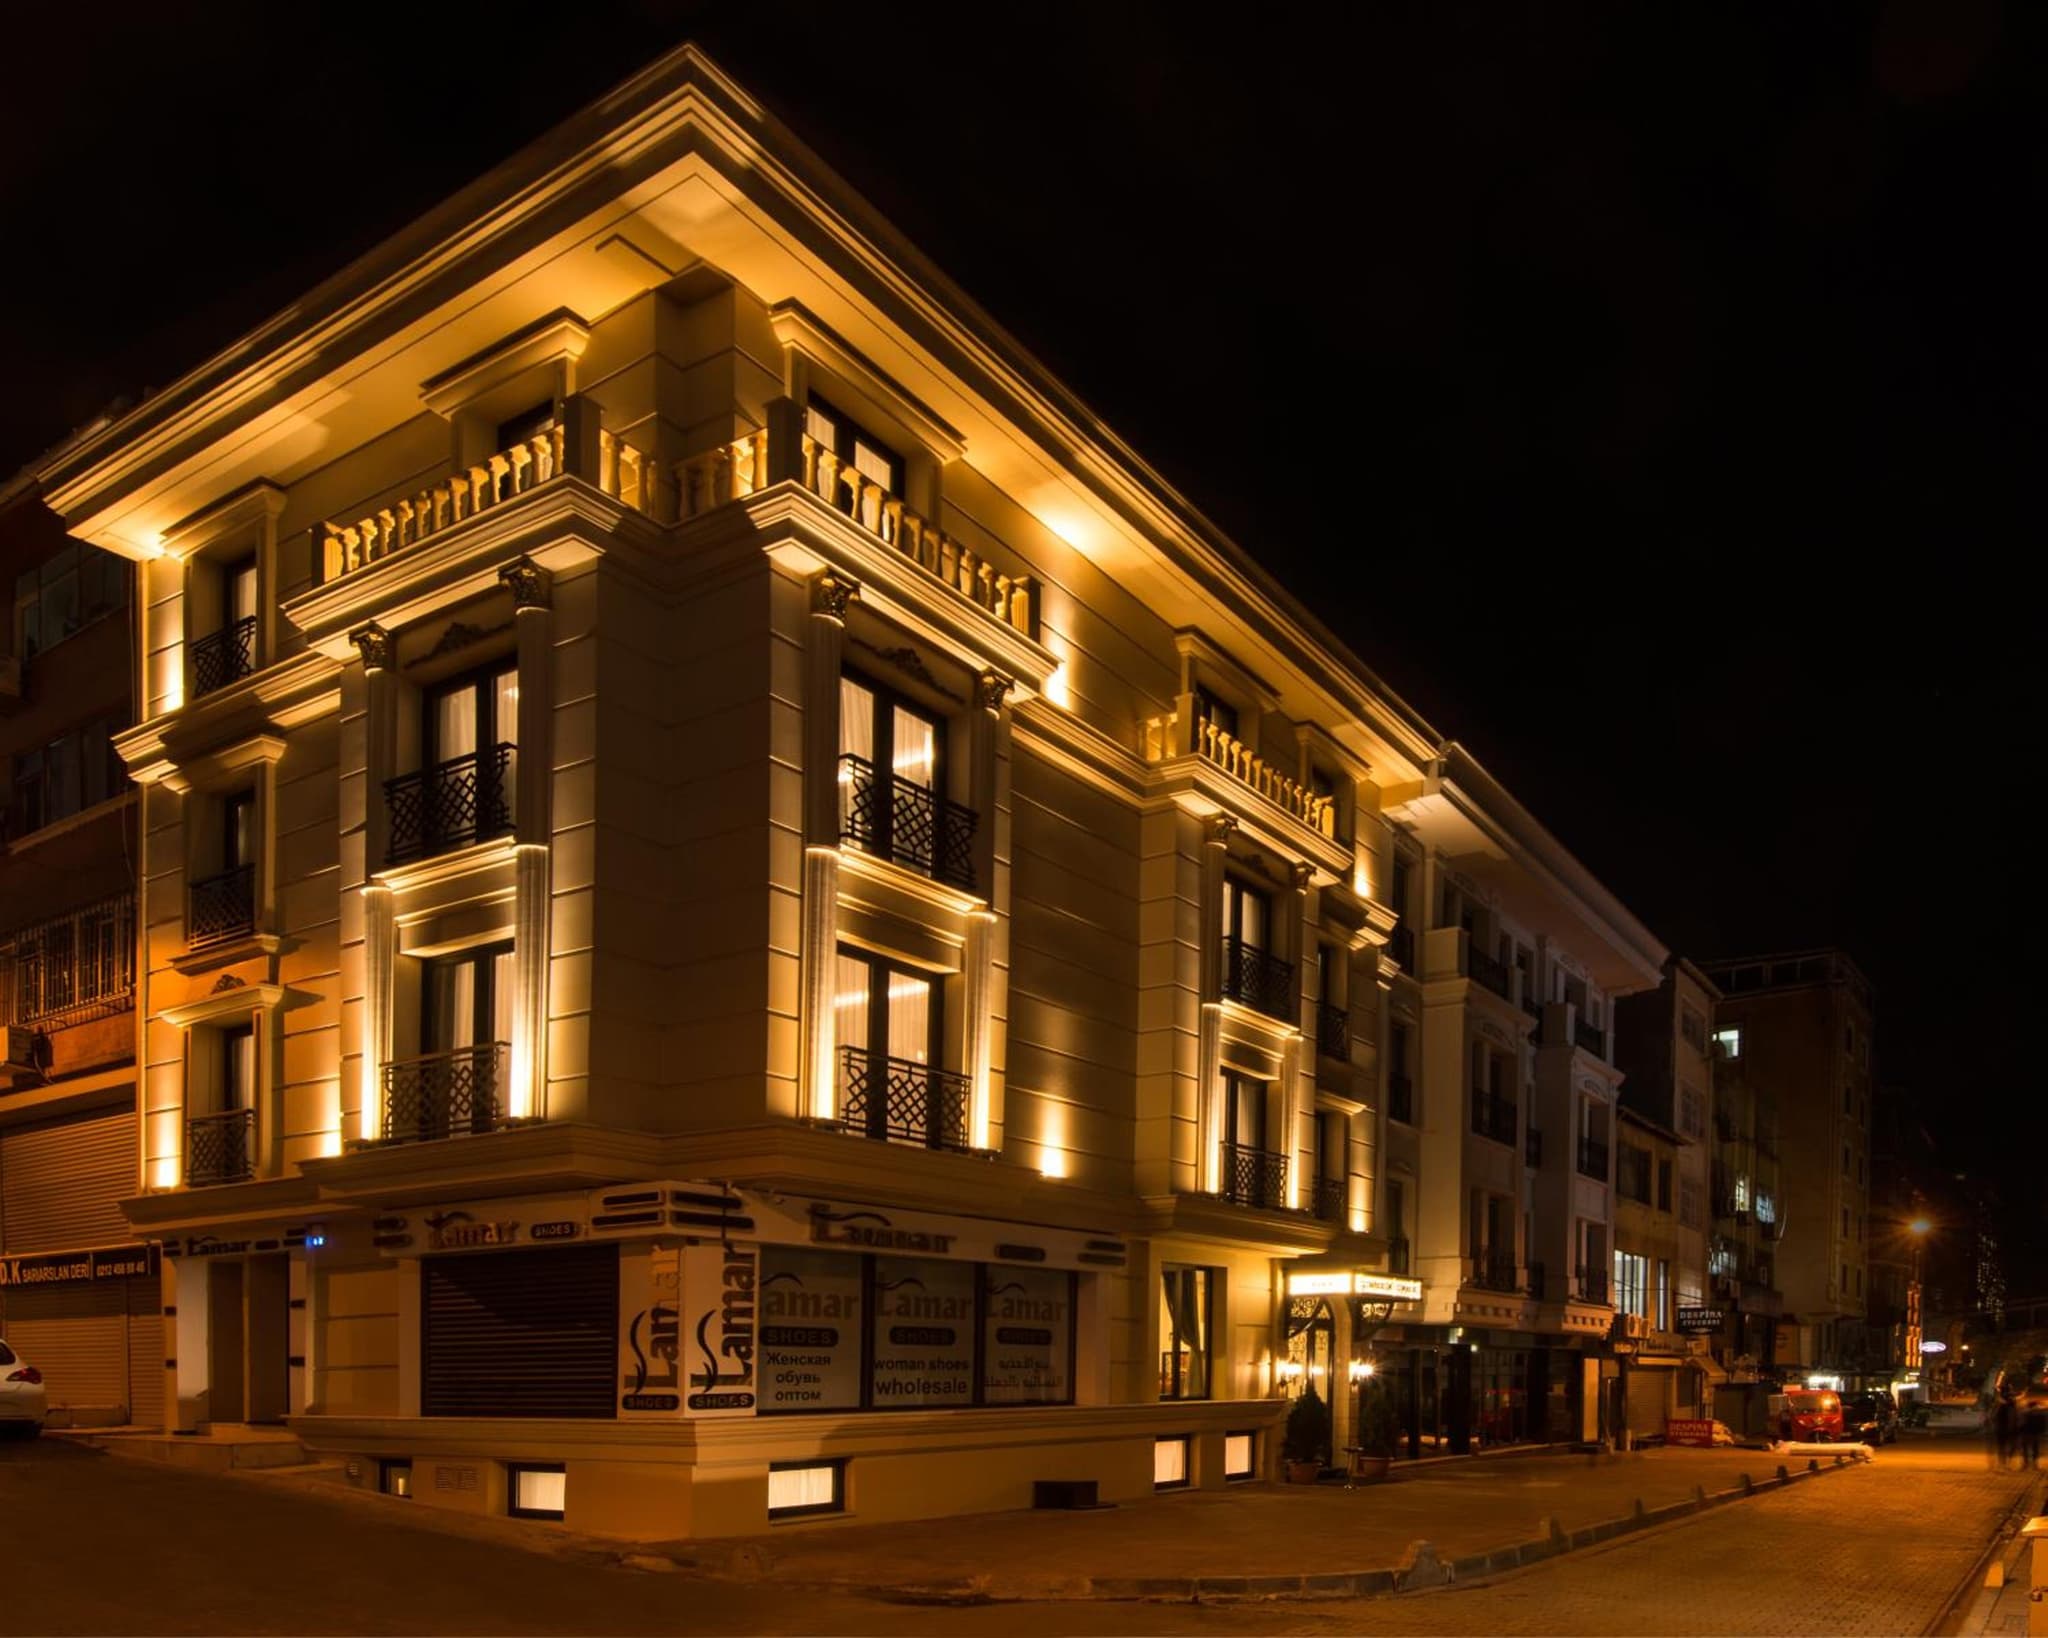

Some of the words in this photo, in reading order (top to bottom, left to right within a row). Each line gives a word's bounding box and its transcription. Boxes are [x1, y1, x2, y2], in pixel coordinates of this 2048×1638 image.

[534, 1222, 572, 1236] SHOES
[765, 1290, 860, 1319] amar
[767, 1329, 833, 1344] SHOES
[767, 1352, 831, 1366] Женская
[874, 1359, 926, 1371] woman
[928, 1356, 969, 1371] shoes
[775, 1370, 821, 1385] обувь
[876, 1378, 967, 1395] wholesale
[696, 1394, 749, 1408] SHOES
[775, 1391, 821, 1401] оптом
